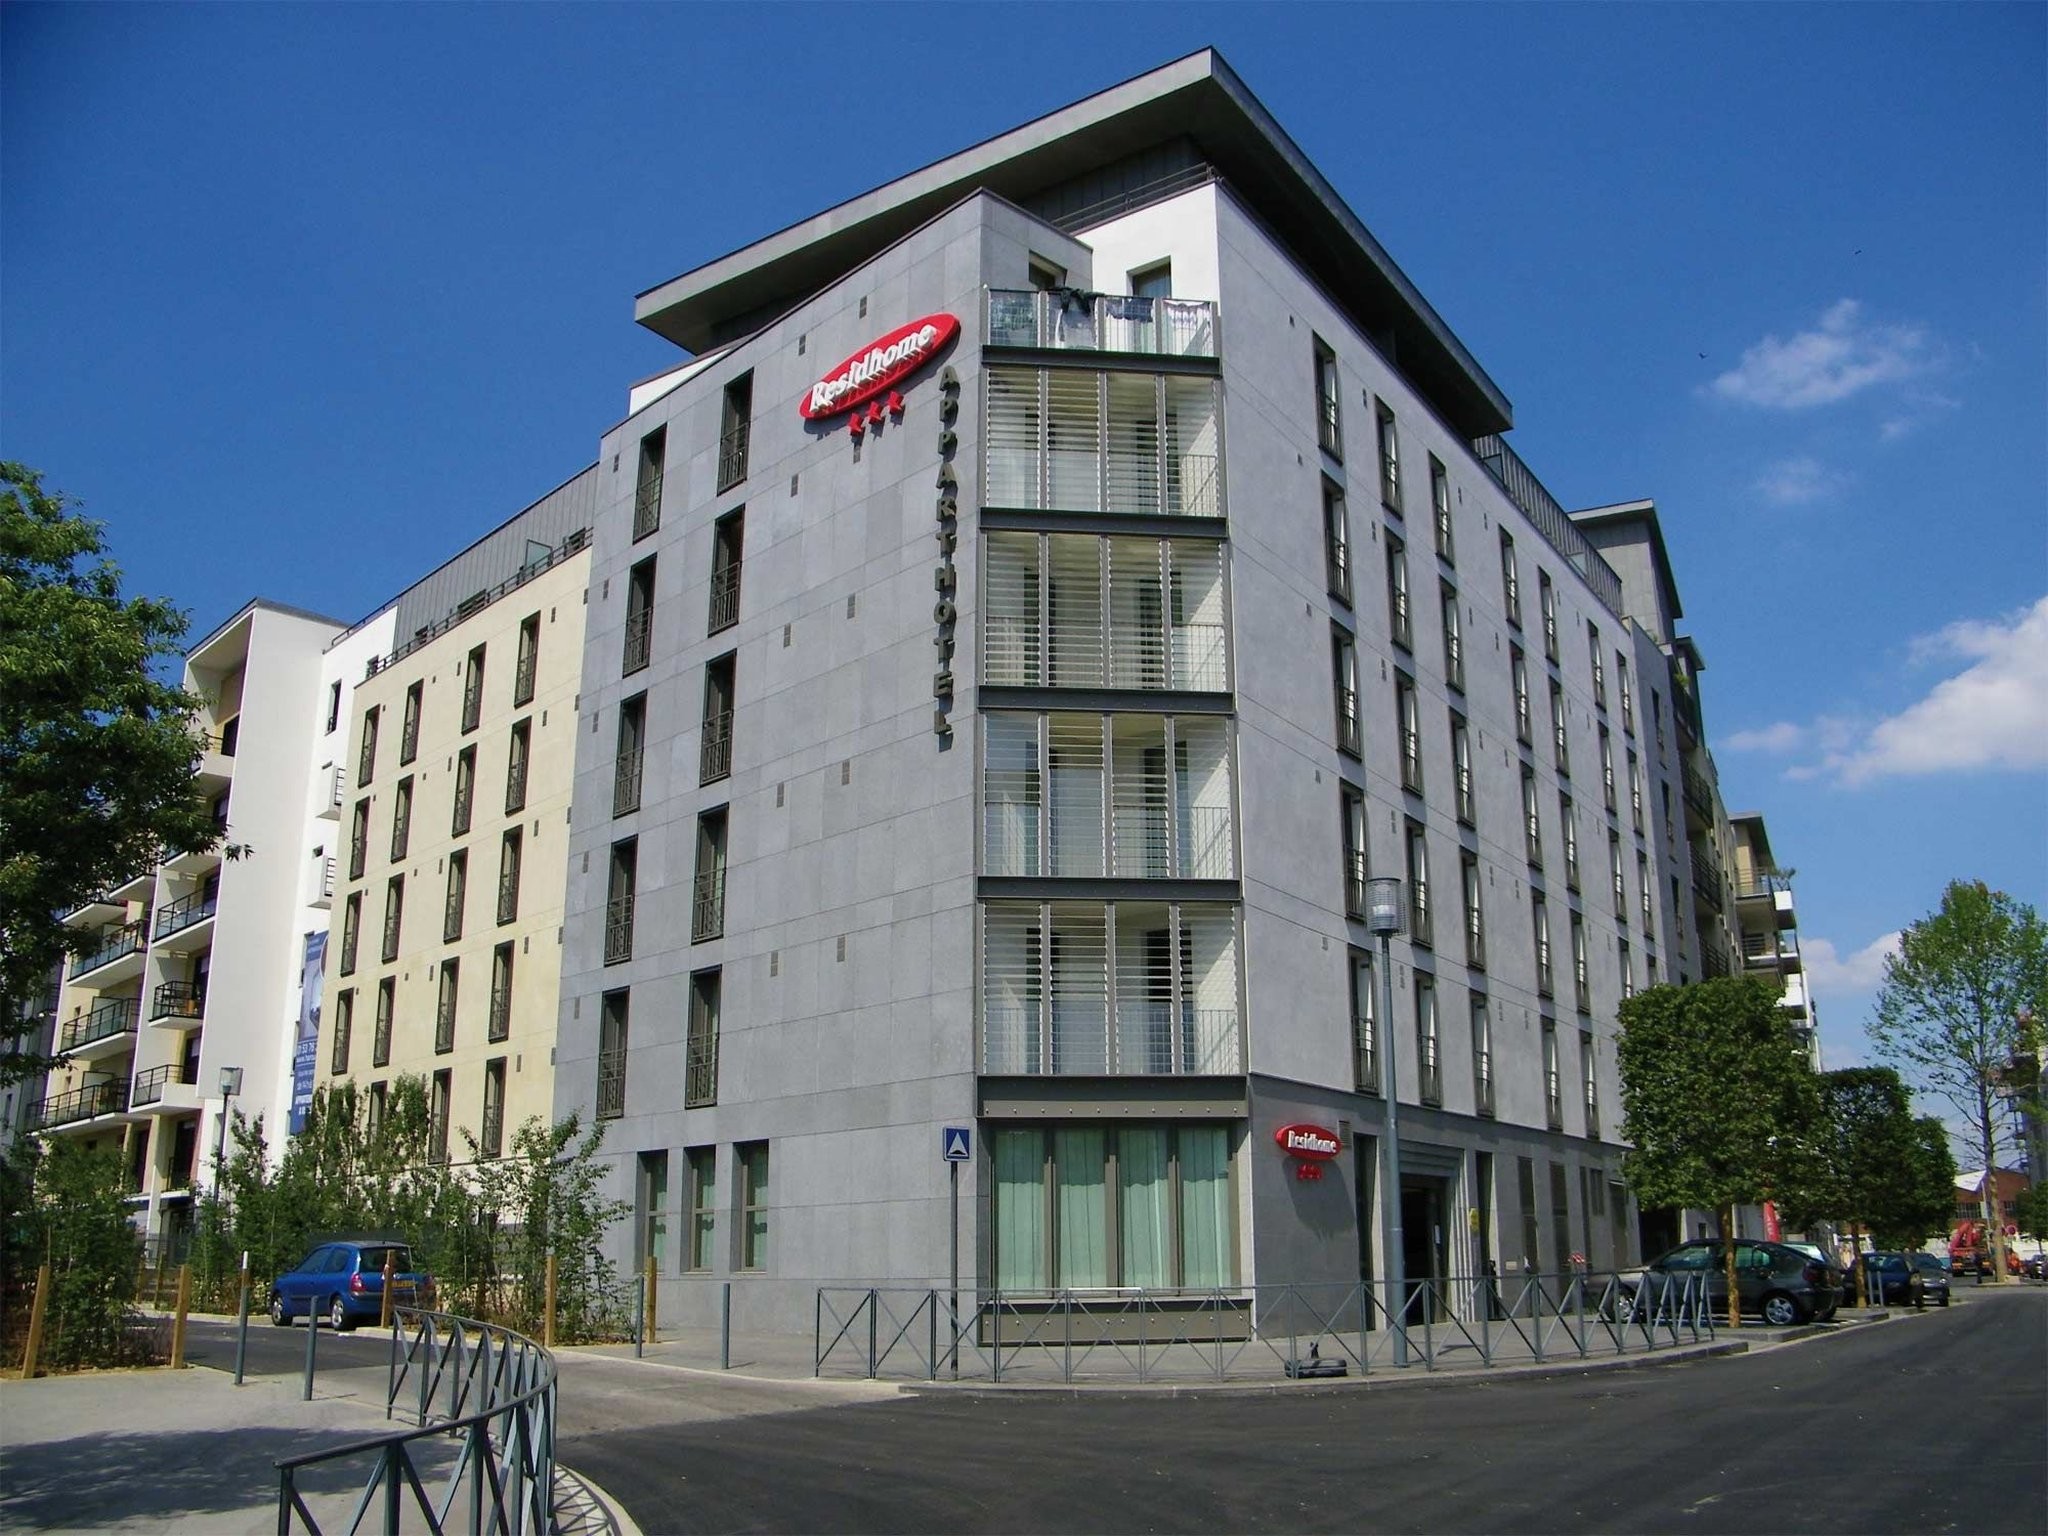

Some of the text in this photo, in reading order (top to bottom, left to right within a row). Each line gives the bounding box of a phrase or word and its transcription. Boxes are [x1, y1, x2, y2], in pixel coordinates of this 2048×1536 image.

[810, 324, 937, 412] Residhome
[933, 365, 959, 736] APPARTHOTEL
[1288, 1130, 1337, 1153] Residhome
